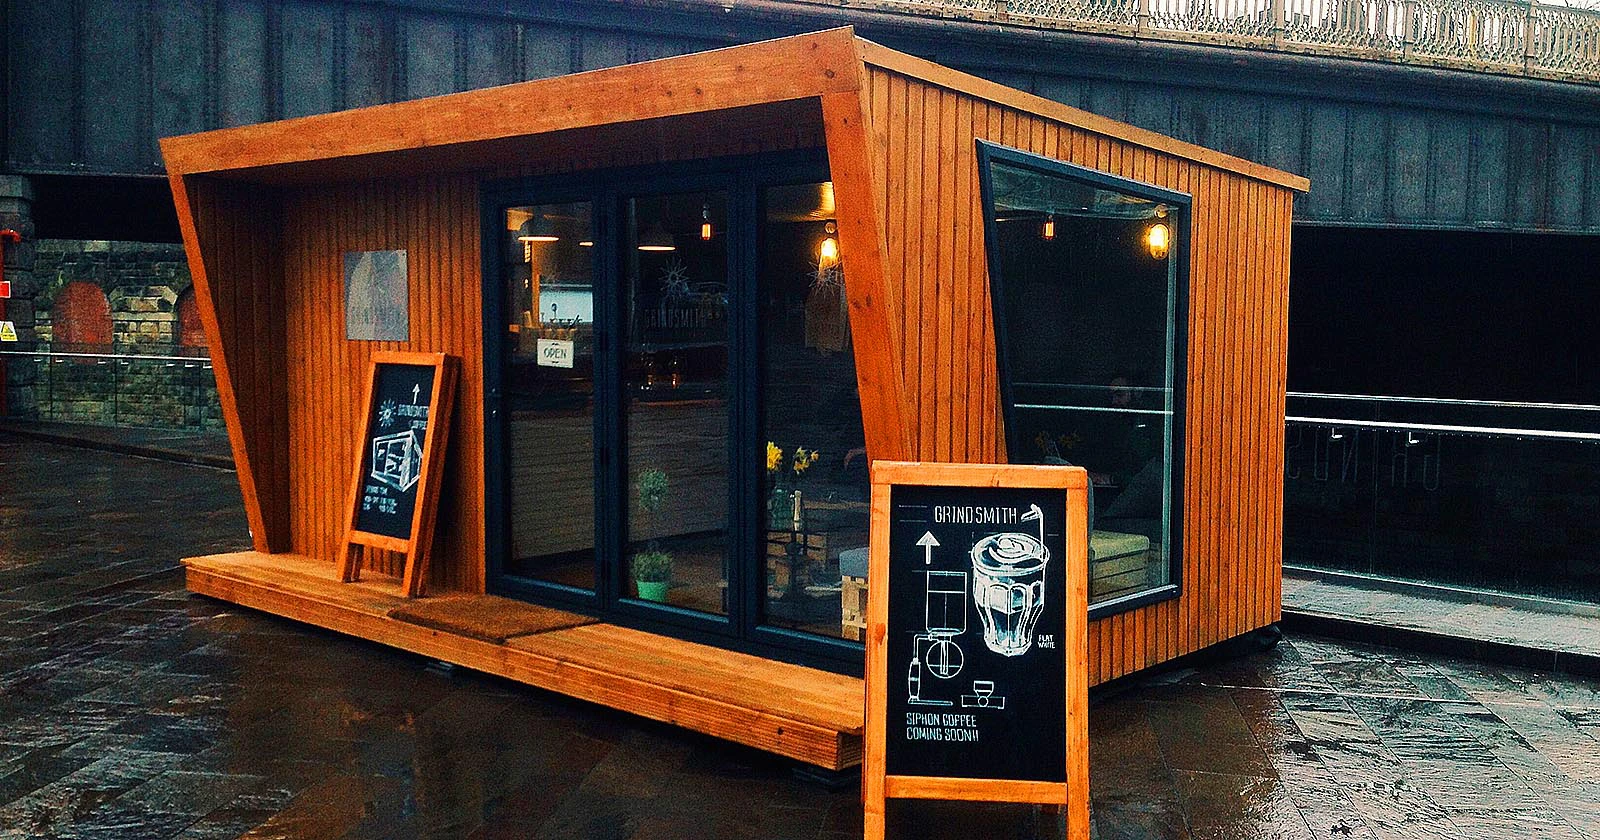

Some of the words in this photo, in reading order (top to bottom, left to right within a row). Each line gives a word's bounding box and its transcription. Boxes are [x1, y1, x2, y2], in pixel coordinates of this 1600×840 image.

[543, 347, 567, 359] OPEN
[934, 505, 1017, 524] GRINDSMITH
[1038, 634, 1054, 642] FLAT
[1037, 641, 1056, 649] WHITE
[906, 712, 940, 726] SIPHON
[942, 713, 977, 727] COFFEE
[906, 726, 943, 741] COMING
